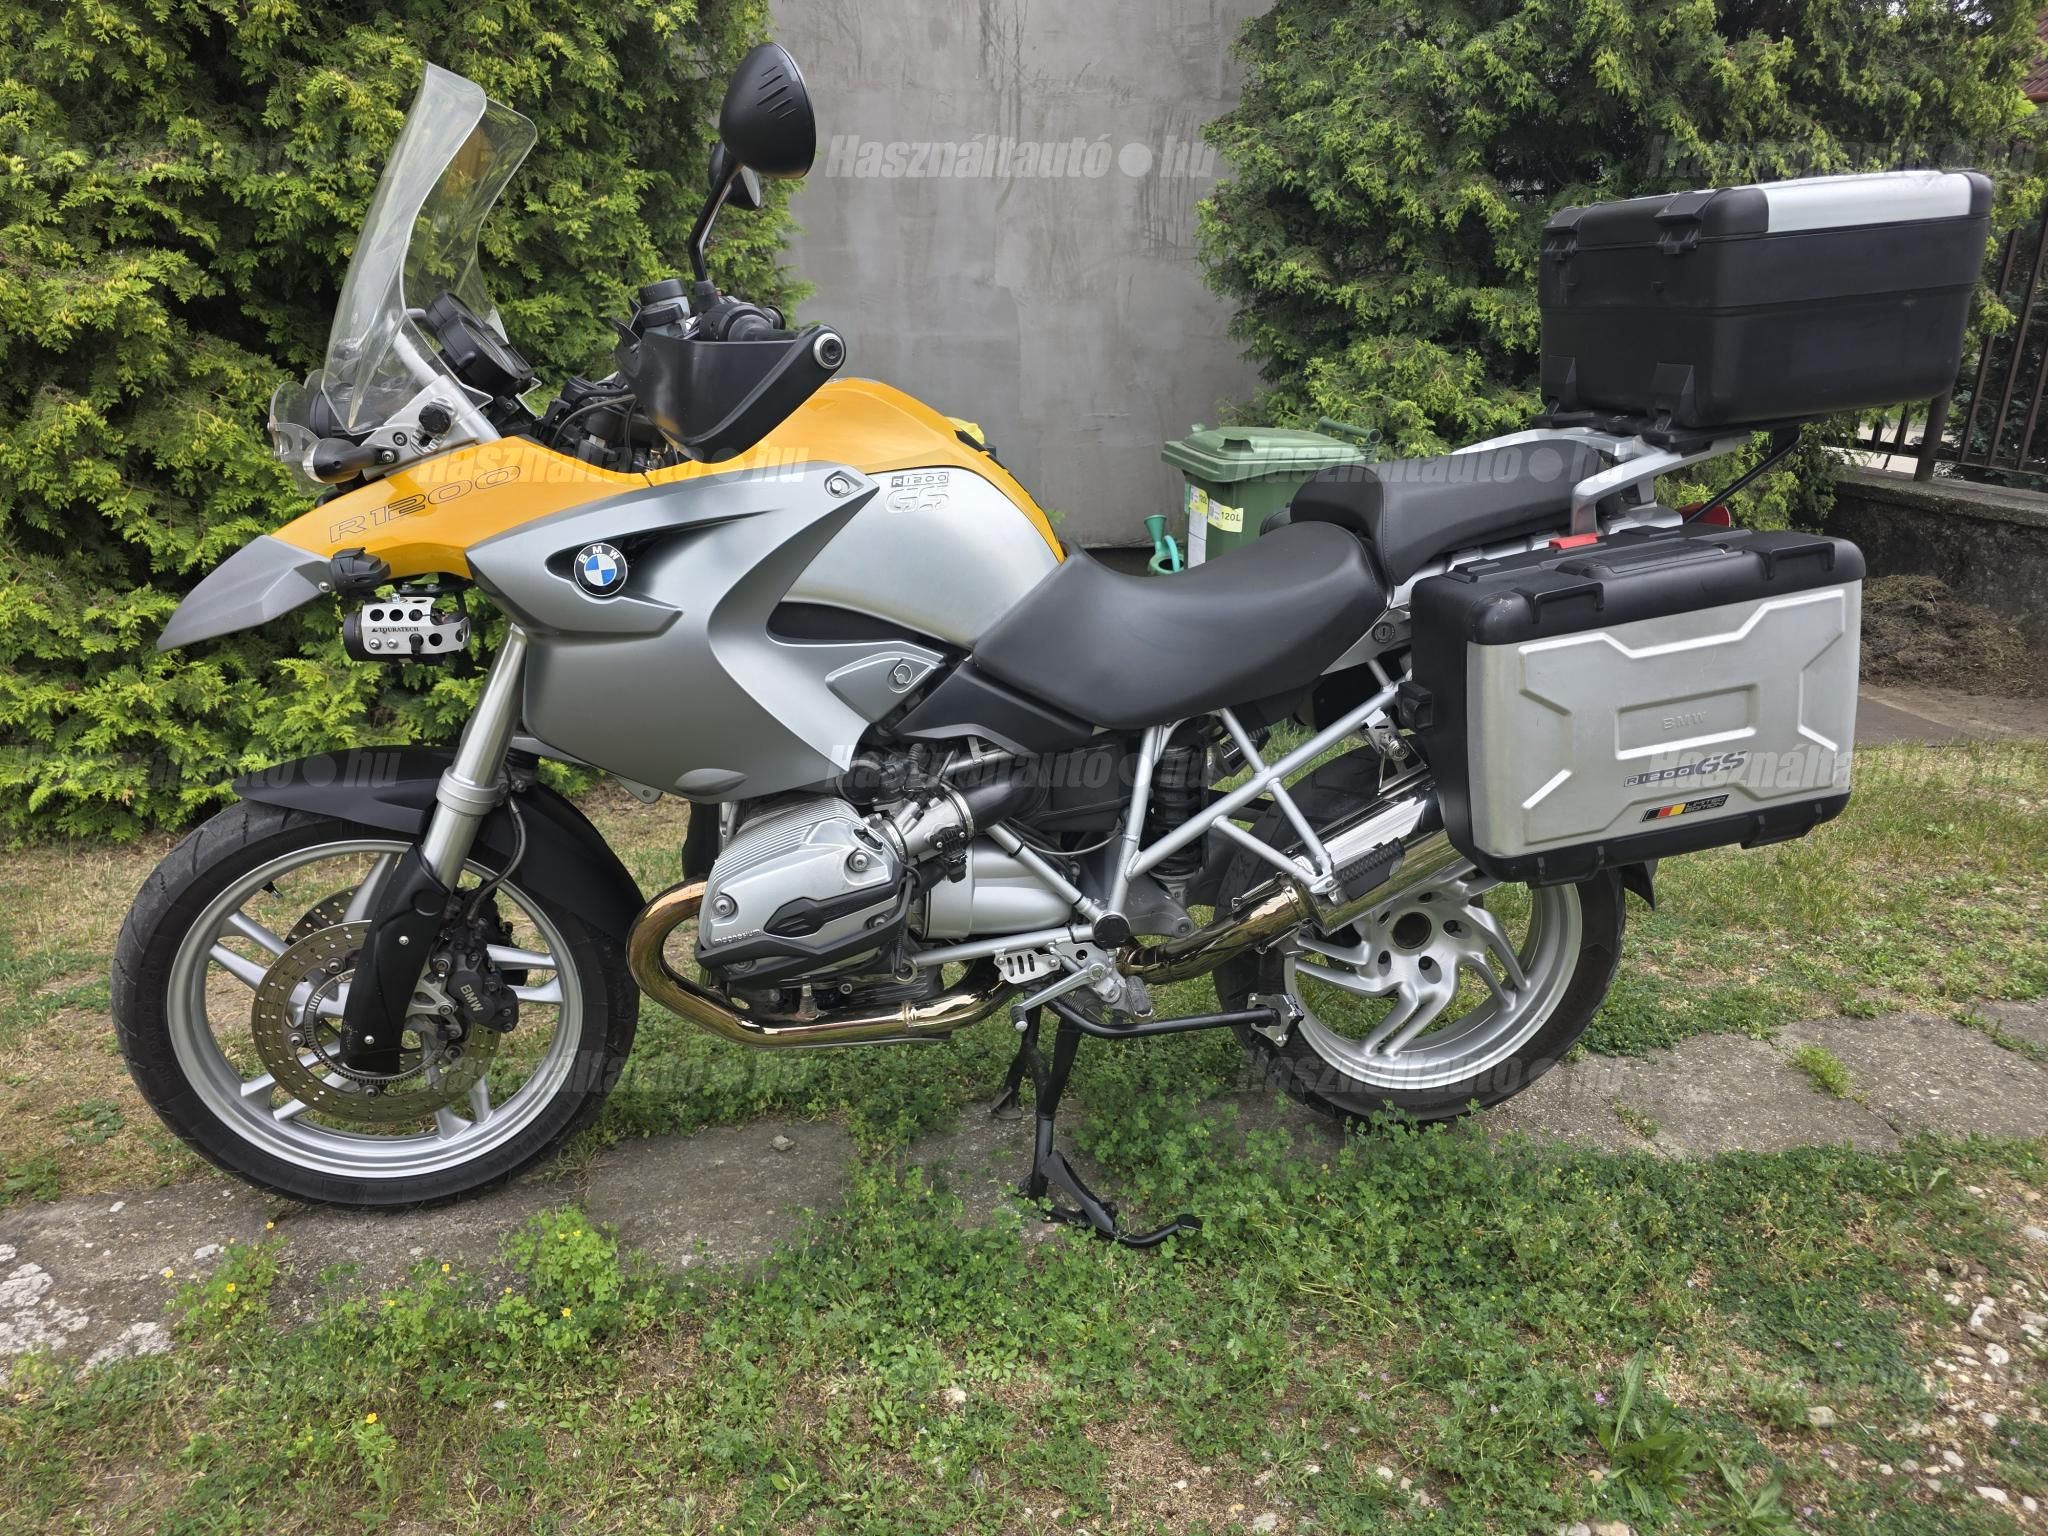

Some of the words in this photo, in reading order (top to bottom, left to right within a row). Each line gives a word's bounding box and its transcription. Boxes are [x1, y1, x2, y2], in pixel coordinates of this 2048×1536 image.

[891, 472, 949, 488] R1200
[885, 485, 950, 514] GS
[1221, 511, 1242, 522] 120L
[578, 545, 620, 564] BMW
[1663, 711, 1707, 729] BMW
[460, 984, 484, 1012] BMW
